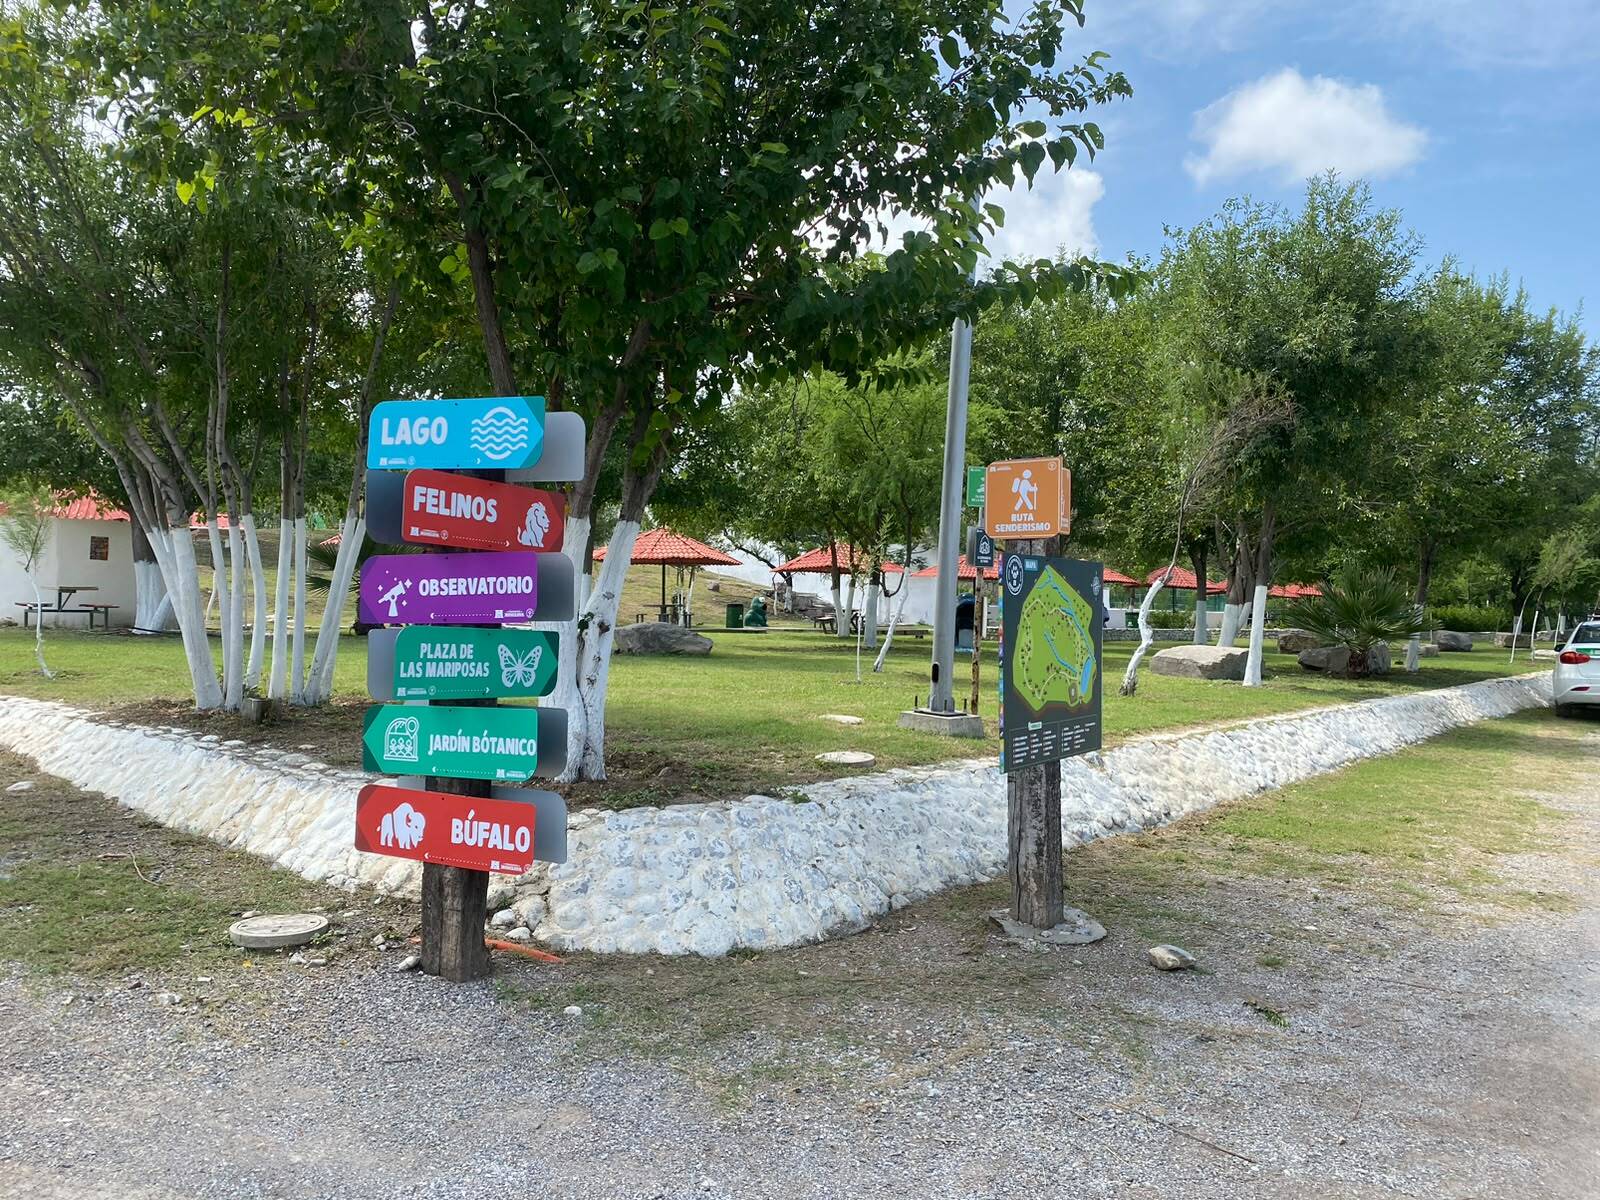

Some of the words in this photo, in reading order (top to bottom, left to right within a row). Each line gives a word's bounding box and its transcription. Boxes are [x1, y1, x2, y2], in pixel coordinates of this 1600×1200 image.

[381, 416, 448, 445] LAGO
[413, 485, 498, 523] FELINOS
[995, 523, 1051, 532] SENDERISMO
[1011, 513, 1034, 522] RUTA
[419, 576, 533, 596] OBSERVATORIO
[420, 643, 457, 660] PLAZA
[459, 644, 474, 660] DE
[400, 661, 422, 678] LAS
[425, 661, 490, 678] MARIPOSAS
[428, 729, 470, 756] JARDÍN
[472, 730, 536, 756] BÓTANICO
[451, 809, 530, 853] BÚFALO
